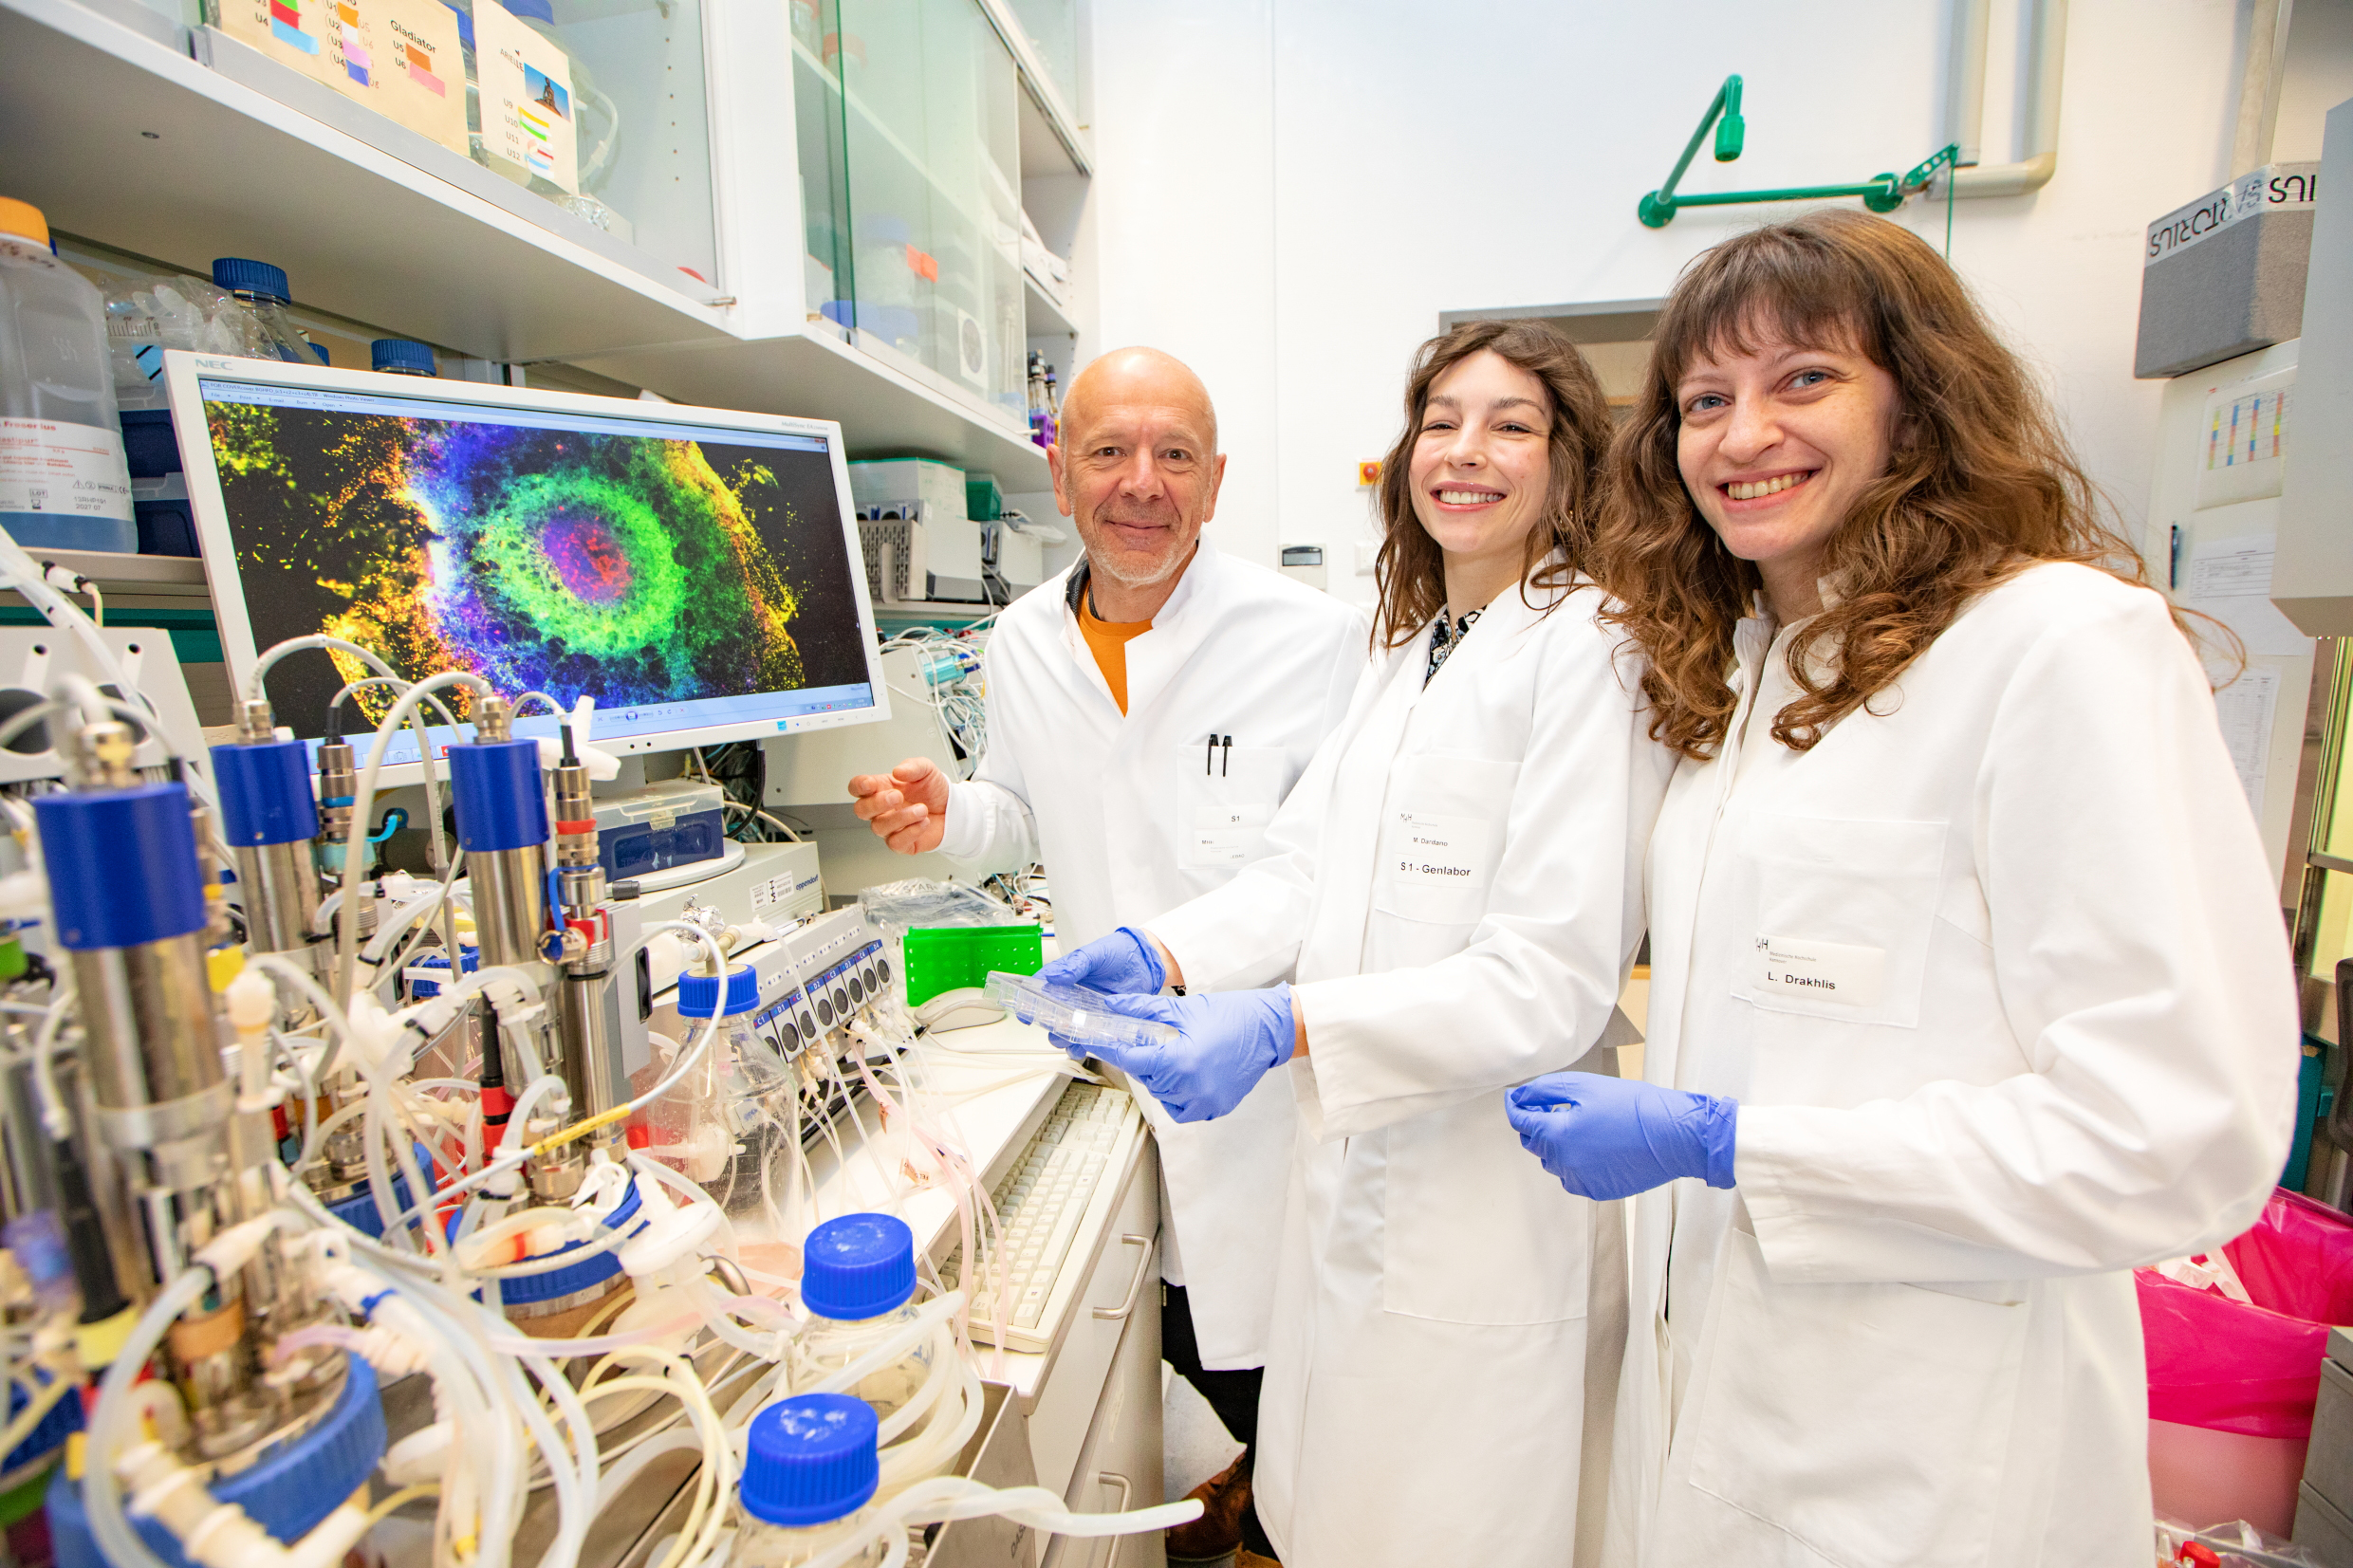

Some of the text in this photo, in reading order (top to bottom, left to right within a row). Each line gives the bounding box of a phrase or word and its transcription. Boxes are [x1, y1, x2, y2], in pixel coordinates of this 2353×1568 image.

[255, 12, 269, 27] U4
[390, 19, 436, 54] Gladiator
[393, 40, 405, 53] U5
[395, 57, 407, 69] U6
[499, 47, 525, 73] ARIELLE
[503, 97, 513, 110] U9
[504, 114, 519, 129] U10
[506, 130, 520, 145] U11
[507, 147, 521, 162] U12
[195, 359, 233, 371] NEC
[1399, 813, 1413, 823] MHH
[1420, 838, 1449, 847] Dardano
[1421, 864, 1472, 876] Genlabor
[795, 874, 819, 892] eppendorf
[873, 942, 880, 951] D4
[859, 951, 866, 960] C4
[844, 961, 852, 970] D3
[829, 969, 837, 979] C3
[813, 981, 821, 990] D2
[1768, 970, 1837, 991] L. Drakhlis
[777, 1004, 786, 1015] D1
[757, 1017, 766, 1025] C1
